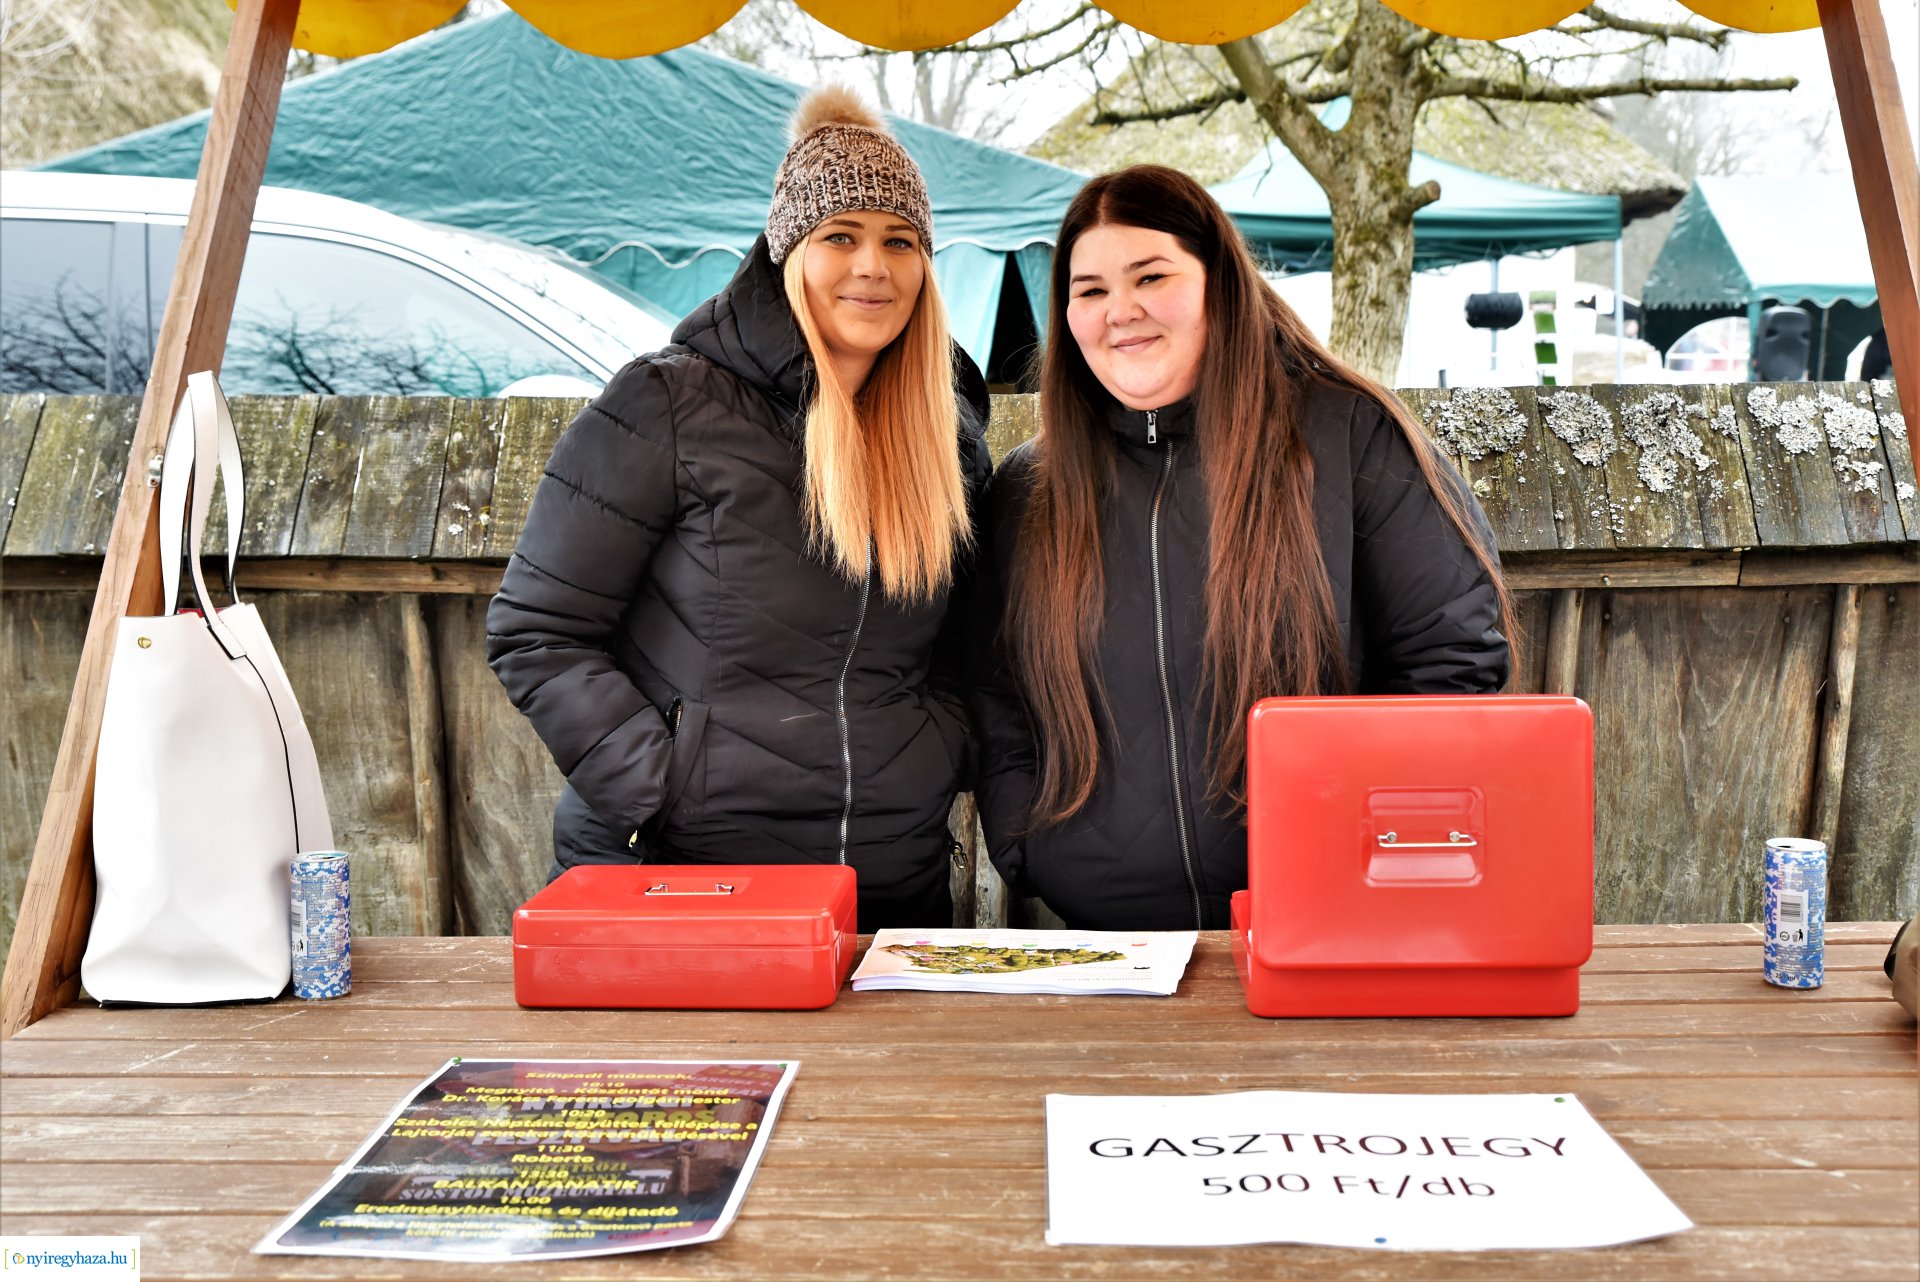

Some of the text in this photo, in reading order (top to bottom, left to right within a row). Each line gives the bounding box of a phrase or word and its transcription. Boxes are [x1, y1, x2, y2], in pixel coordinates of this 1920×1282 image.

[546, 1095, 608, 1103] Ferenc
[612, 1096, 741, 1105] polgármester
[394, 1118, 478, 1127] Szabolcs
[745, 1122, 758, 1130] a
[480, 1129, 557, 1138] zenekar
[537, 1145, 585, 1153] 11:30
[1088, 1133, 1567, 1159] GASZTROJEGY
[511, 1154, 595, 1163] Roberto
[433, 1180, 639, 1189] BALKAN FANATIK
[1202, 1173, 1496, 1199] 500 Ft/db
